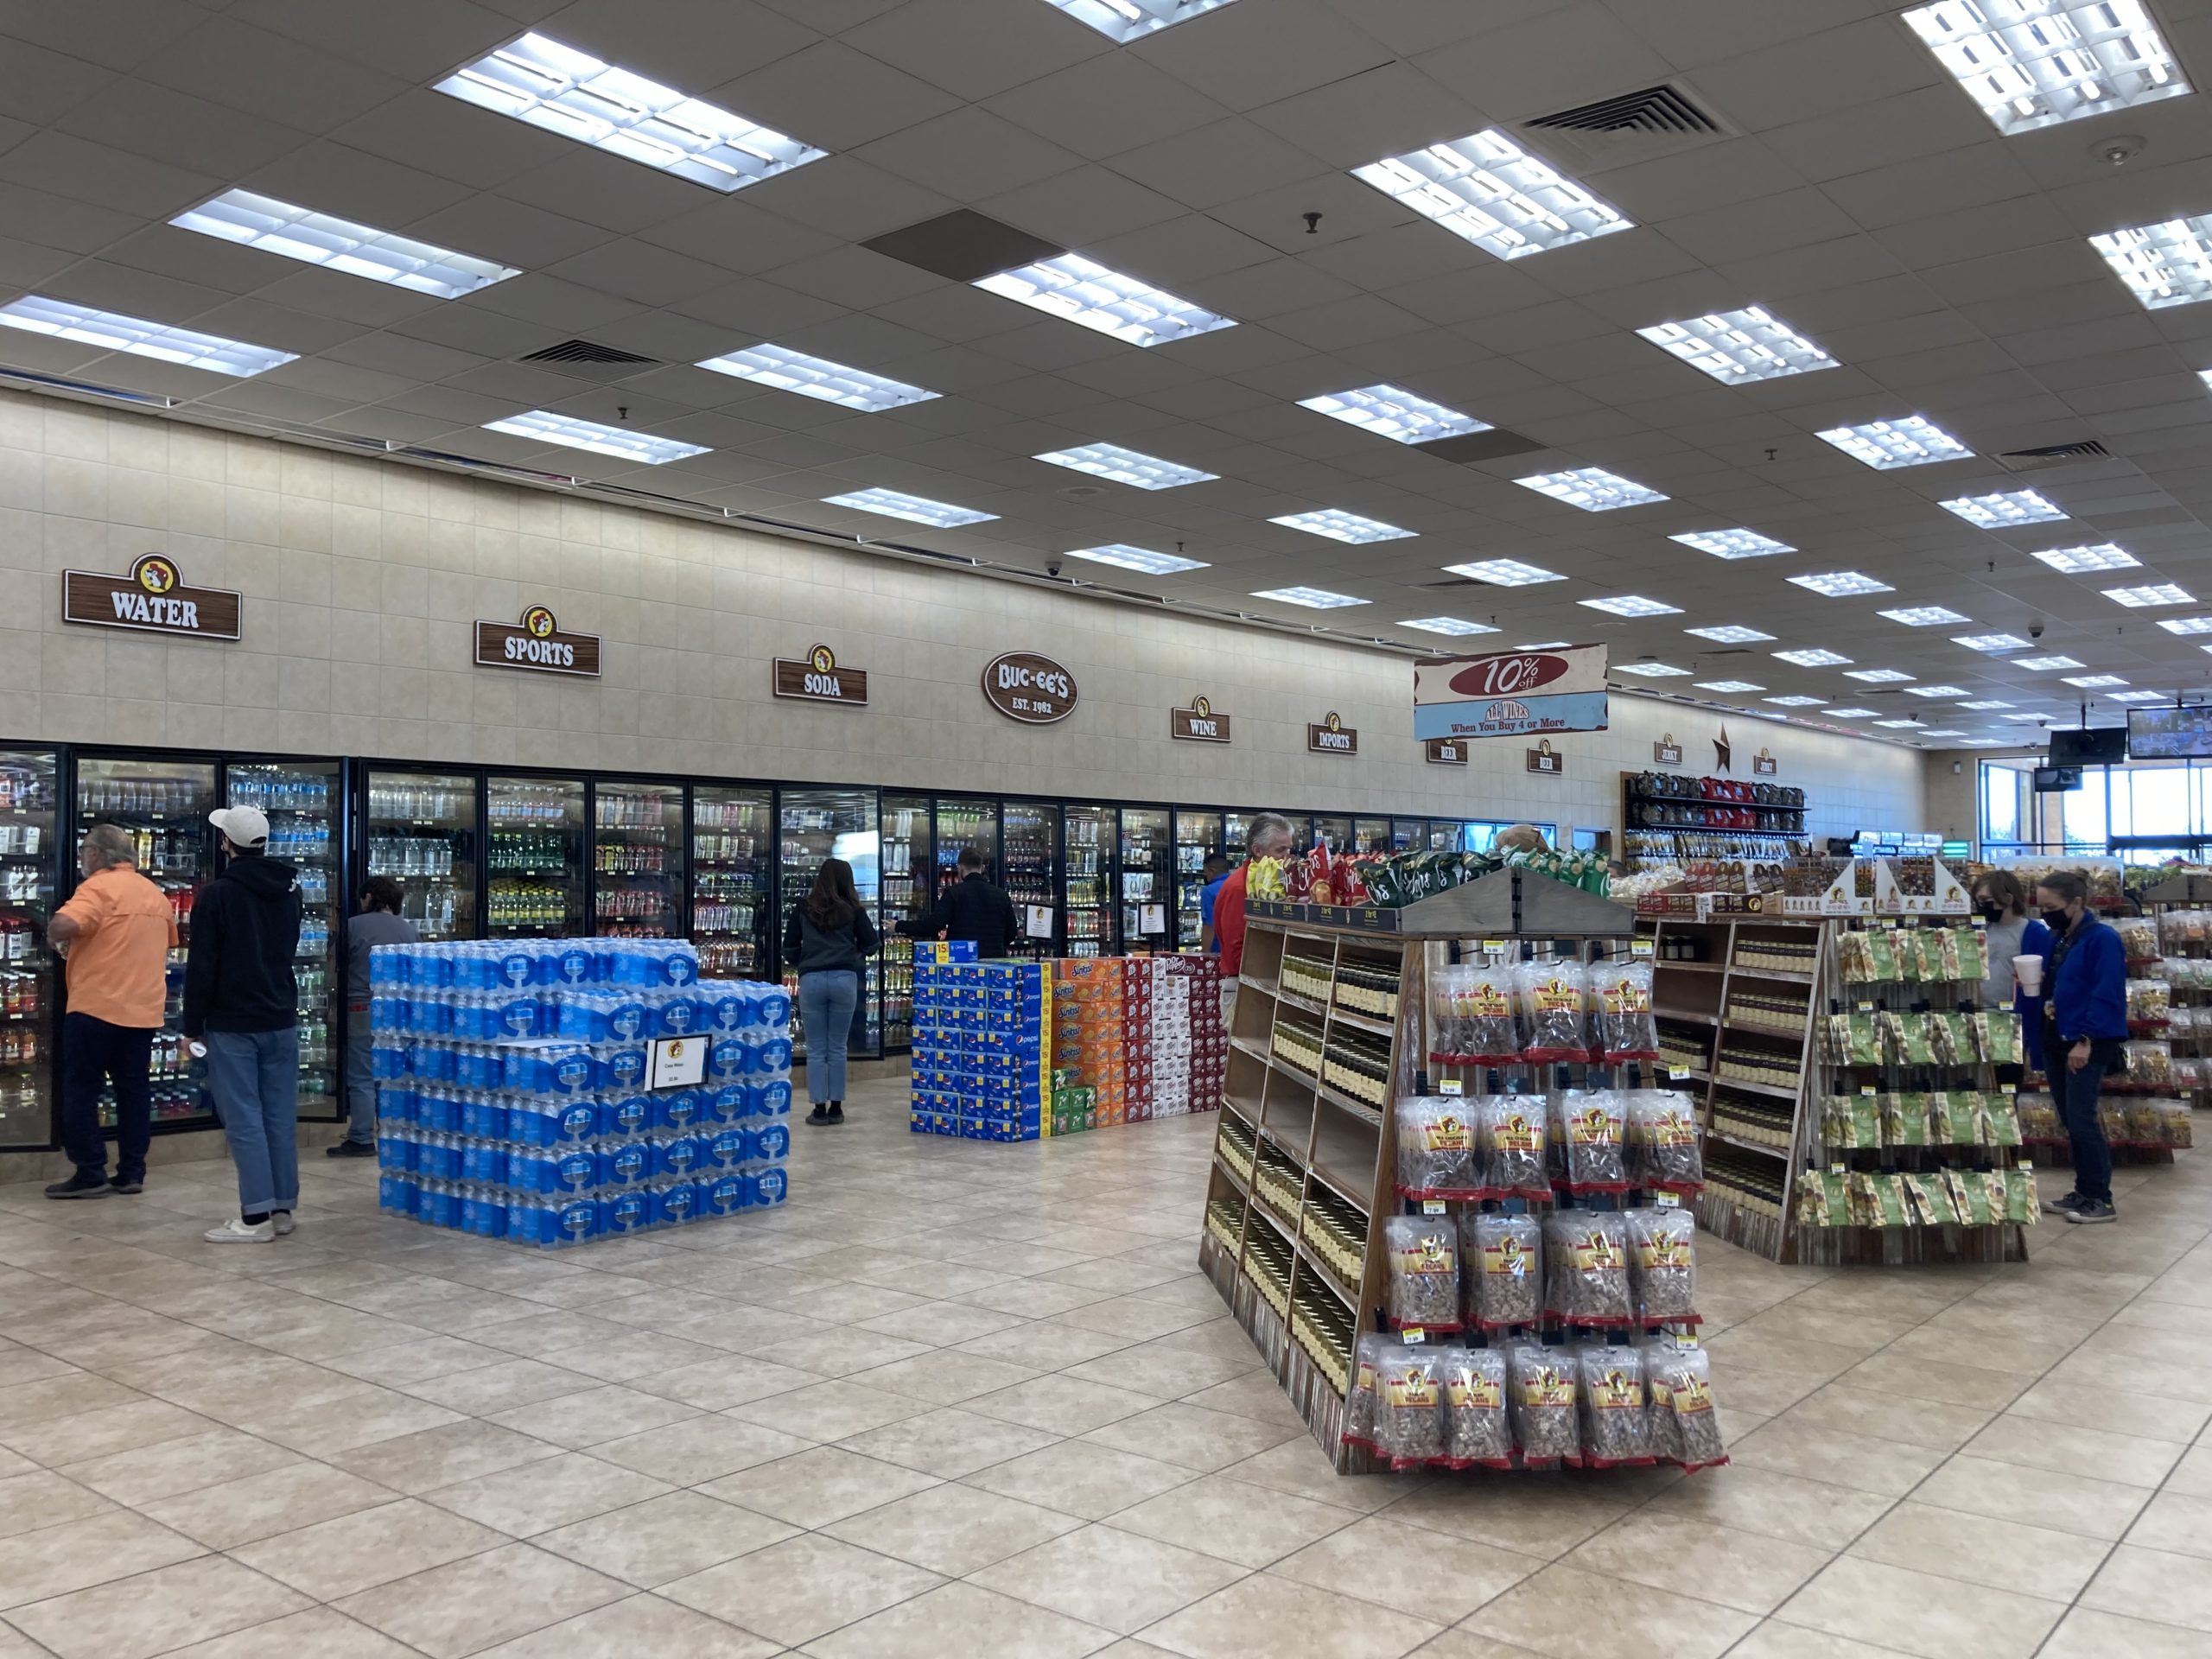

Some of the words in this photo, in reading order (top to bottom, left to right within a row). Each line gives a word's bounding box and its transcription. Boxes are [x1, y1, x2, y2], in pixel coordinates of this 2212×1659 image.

[111, 592, 199, 628] WATER
[505, 636, 574, 666] SPORTS
[1484, 658, 1540, 693] 10%
[1518, 677, 1538, 690] off
[804, 673, 841, 696] SODA
[1012, 697, 1030, 710] EST.
[1033, 701, 1052, 714] 1982
[1485, 703, 1502, 721] ALL
[1501, 700, 1529, 720] WINES
[1189, 719, 1217, 736] WINE
[1451, 723, 1476, 734] When
[1478, 721, 1496, 732] You
[1498, 720, 1516, 732] Buy
[1518, 720, 1524, 729] 4
[1540, 718, 1565, 728] More
[1319, 732, 1350, 748] IMPORTS
[1440, 746, 1457, 760] BEER
